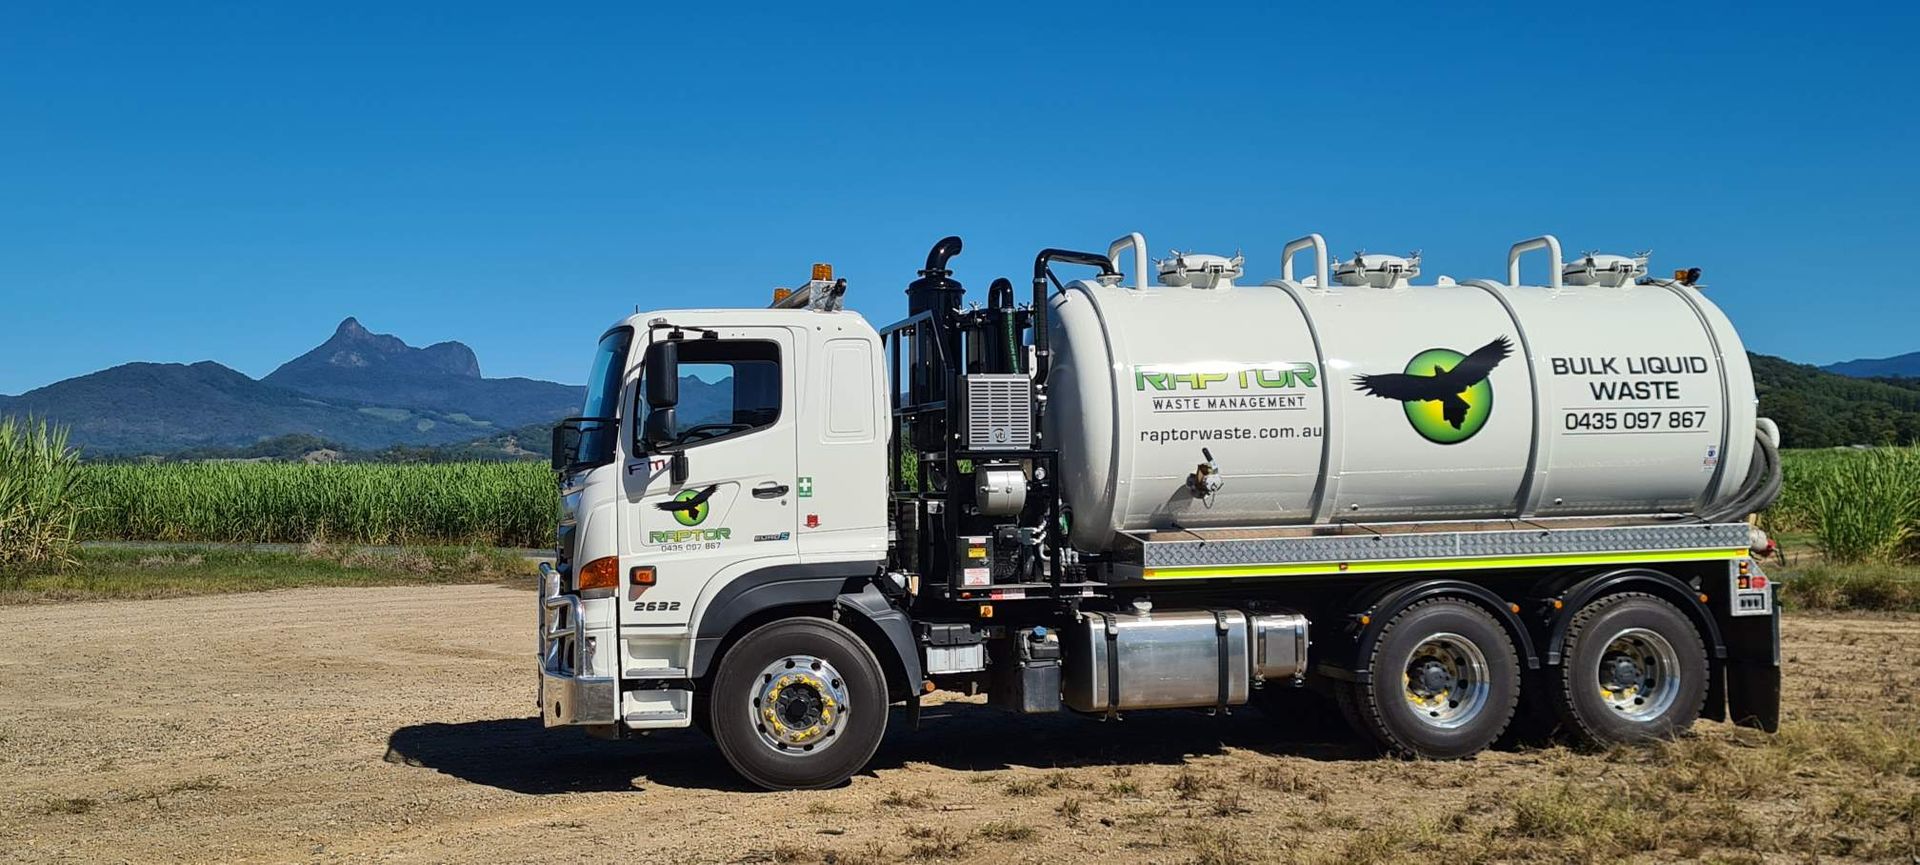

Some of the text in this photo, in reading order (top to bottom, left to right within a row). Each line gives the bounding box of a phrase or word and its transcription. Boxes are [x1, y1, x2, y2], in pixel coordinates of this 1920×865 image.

[1551, 356, 1708, 375] BULK LIQUID
[1134, 362, 1318, 391] RAPTOR
[1589, 381, 1680, 400] WASTE
[1153, 396, 1305, 409] WASTE MANAGEMENT
[1565, 411, 1706, 430] 0435 097 867
[1140, 427, 1322, 445] raptorwaste.com.au
[649, 528, 731, 543] RAPTOR
[705, 542, 721, 550] 867
[634, 601, 681, 611] 2632
